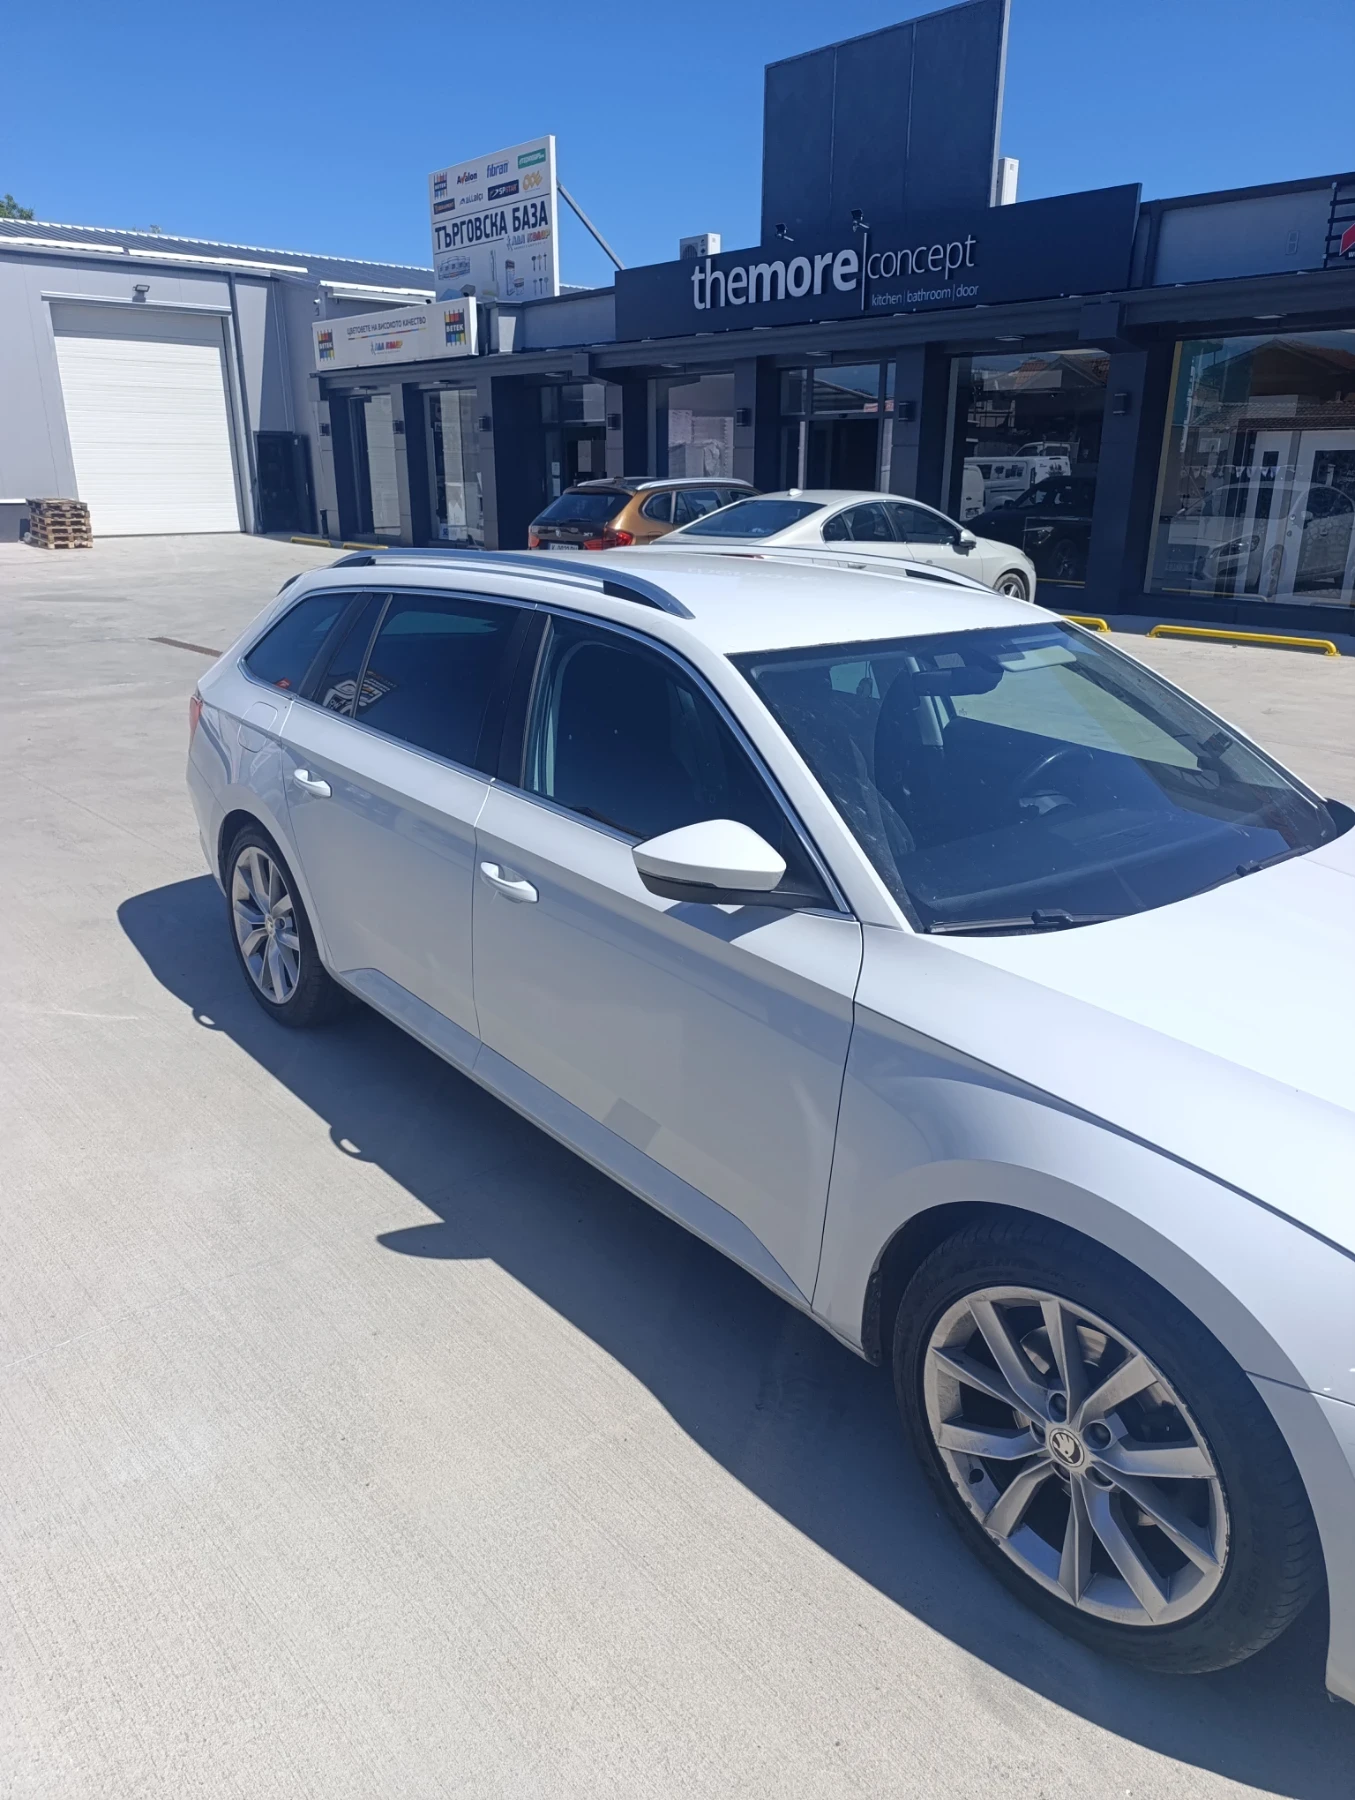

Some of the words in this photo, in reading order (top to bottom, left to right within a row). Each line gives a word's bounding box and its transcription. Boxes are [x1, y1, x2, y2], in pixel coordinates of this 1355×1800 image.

[435, 210, 508, 250] ТЪРГОВСКА
[512, 200, 548, 232] БАЗА
[690, 249, 859, 311] themore
[867, 234, 977, 281] concept
[871, 292, 902, 306] kitchen
[906, 287, 951, 303] bathroom
[956, 284, 979, 298] door
[378, 319, 402, 330] ВИСОКОТО
[402, 316, 427, 327] КАЧЕСТВО
[446, 323, 465, 333] BETEK
